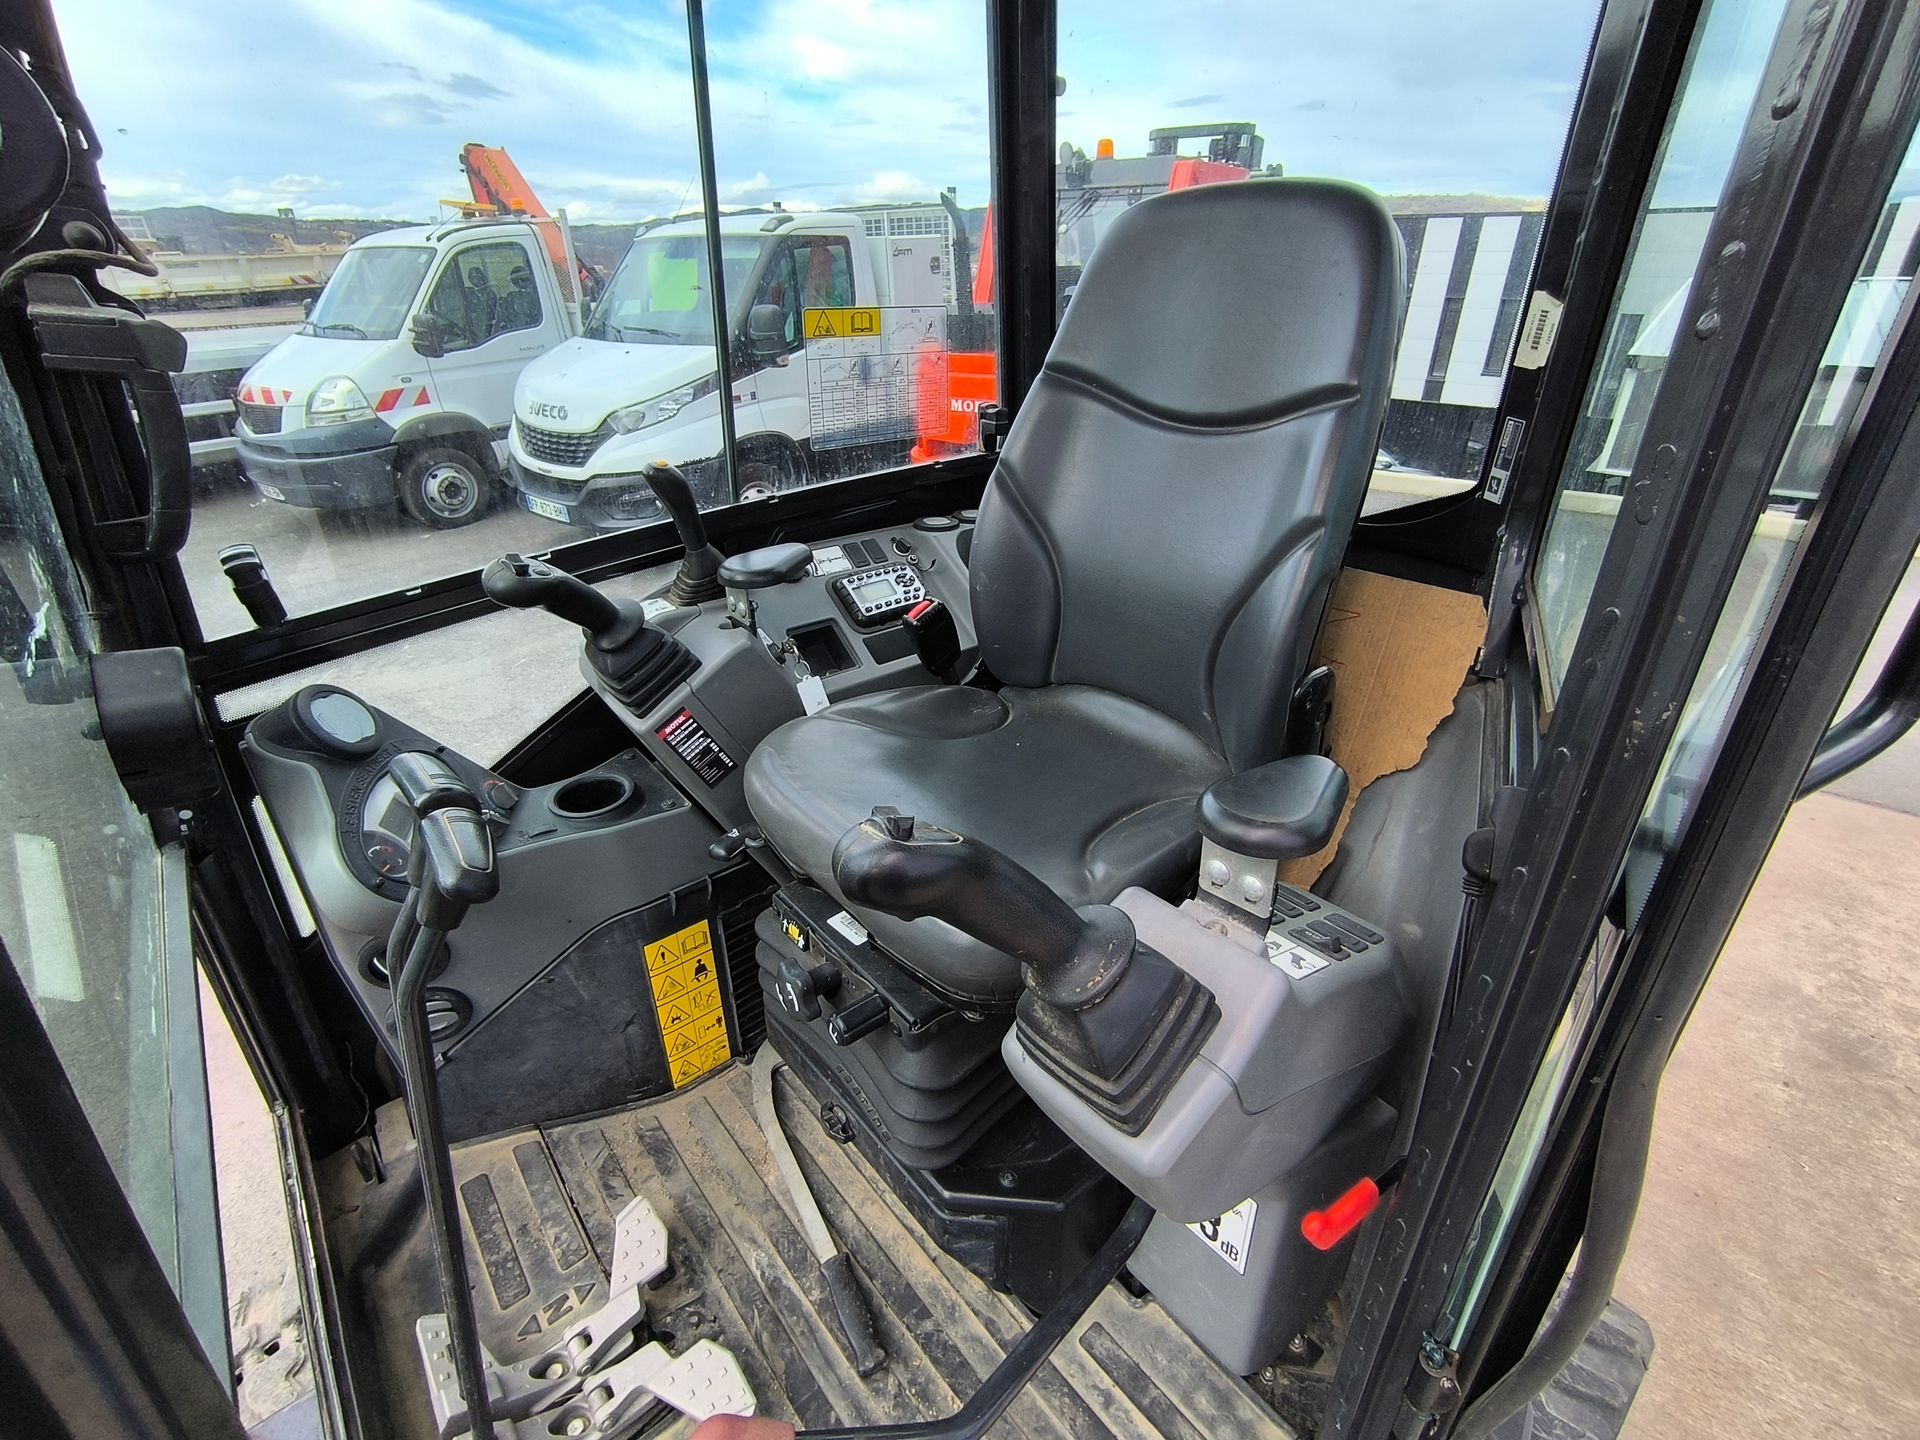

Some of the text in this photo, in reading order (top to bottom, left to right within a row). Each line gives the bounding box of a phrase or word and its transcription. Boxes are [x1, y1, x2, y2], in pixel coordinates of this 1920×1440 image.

[529, 401, 569, 421] IVECO
[664, 714, 687, 735] MOTUL
[345, 786, 362, 827] FASTEN
[1220, 1240, 1239, 1262] dB
